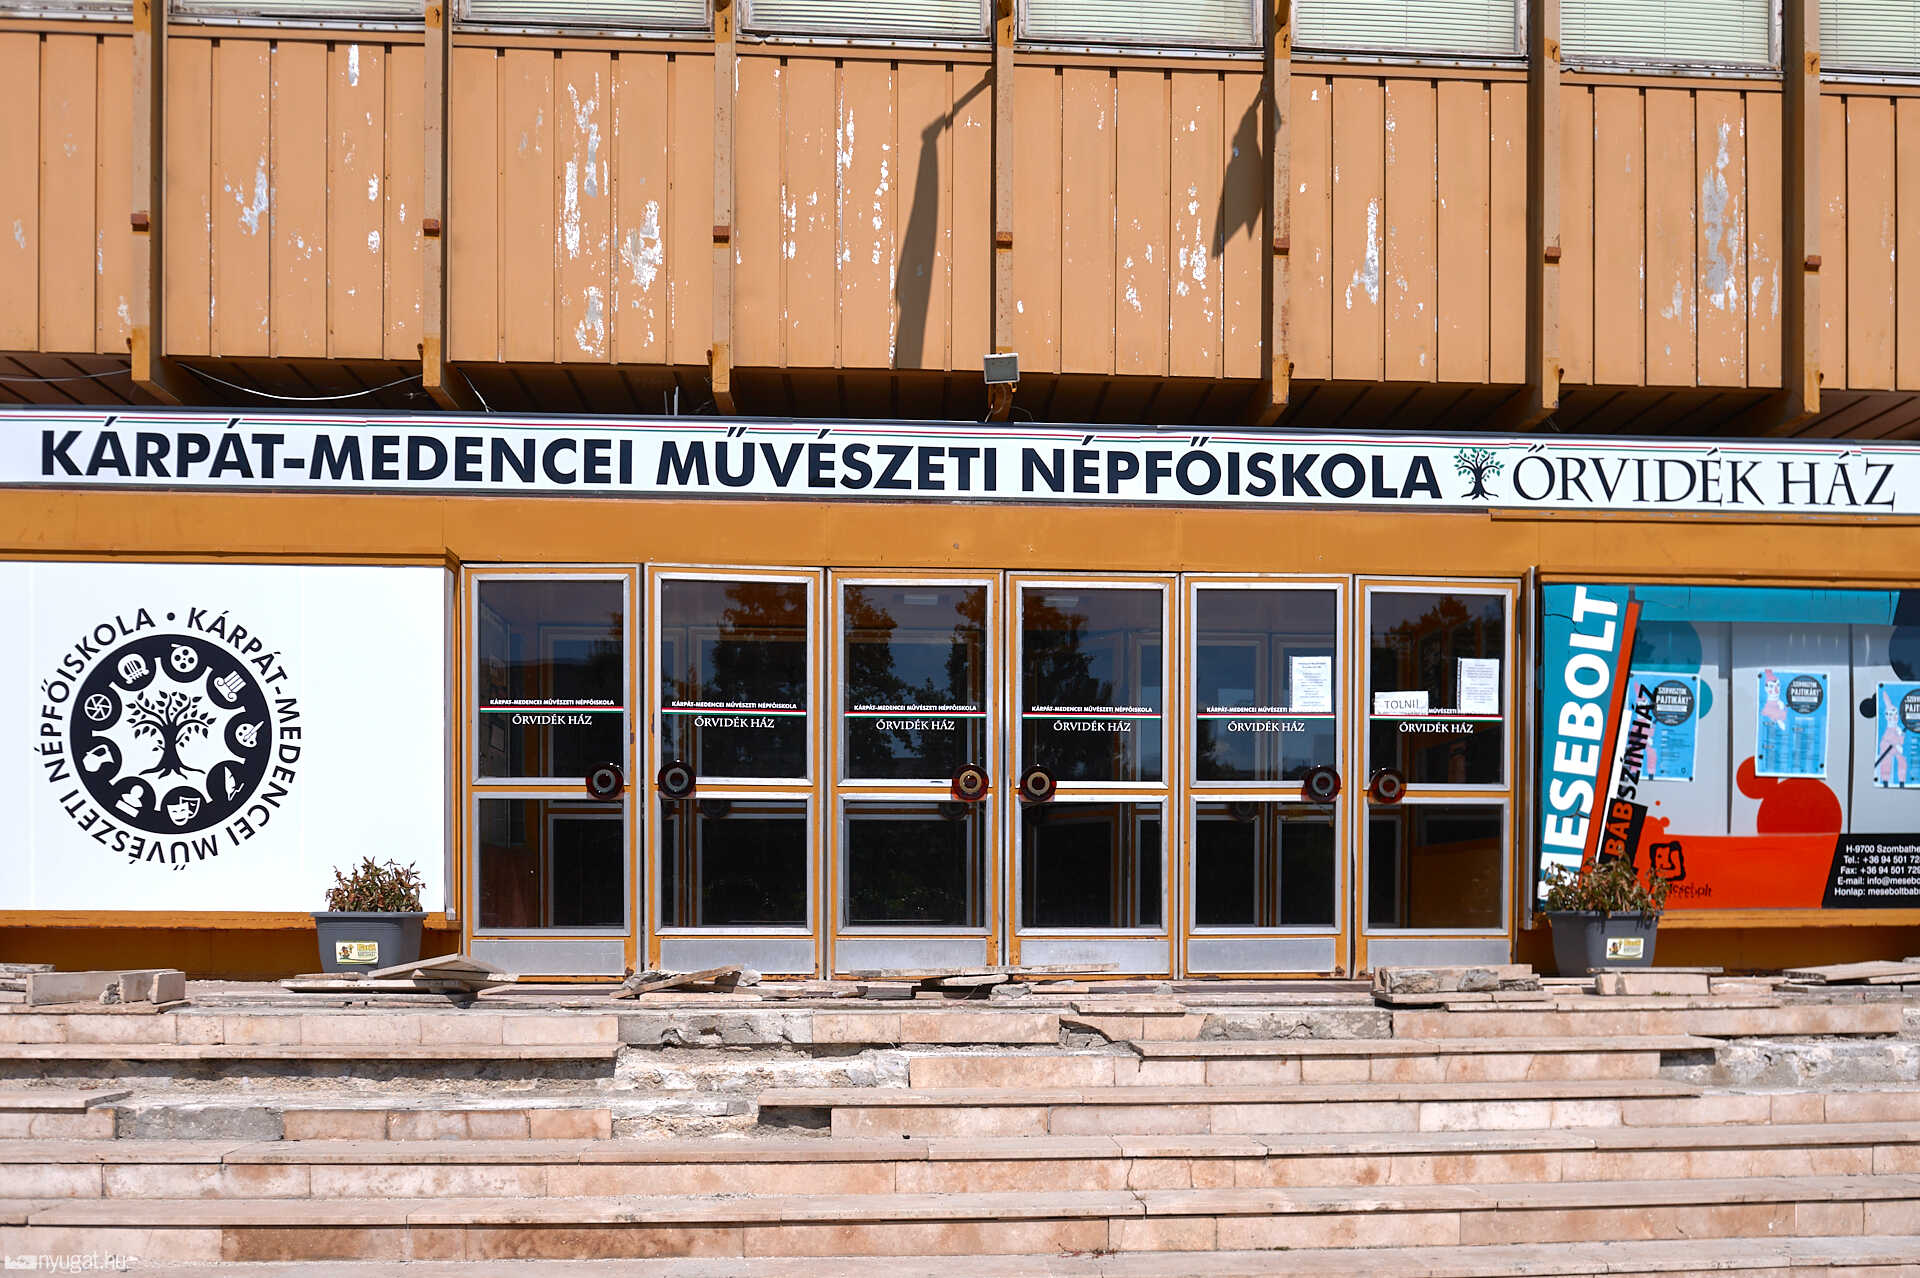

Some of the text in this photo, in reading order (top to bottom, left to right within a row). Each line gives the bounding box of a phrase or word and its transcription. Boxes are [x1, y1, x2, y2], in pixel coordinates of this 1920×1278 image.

[41, 415, 1443, 499] KÁRPÁT-MEDENCEI MŰVÉSZETI NÉPFŐISKOLA
[1512, 443, 1897, 512] ŐRVIDÉK HÁZ
[512, 713, 593, 726] ŐRVIDÉK HÁZ
[694, 716, 775, 729] ŐRVIDÉK HÁZ
[875, 719, 955, 731] ŐRVIDÉK HÁZ
[1053, 720, 1131, 732] ŐRVIDÉK HÁZ
[1227, 720, 1305, 732] ŐRVIDÉK HÁZ
[1399, 722, 1474, 734] ŐRVIDÉK HÁZ
[33, 606, 302, 871] KÁRPÁT-MEDENCEI MŰVÉSZETI NÉPFŐISKOLA
[1846, 844, 1875, 853] H-9700
[1843, 855, 1860, 864] Tel.:
[1863, 855, 1879, 864] +36
[1881, 855, 1891, 864] 94
[1893, 855, 1907, 864] 501
[1840, 866, 1857, 874] Fax:
[1860, 866, 1877, 874] +36
[1878, 866, 1889, 874] 94
[1890, 866, 1905, 874] 501
[1837, 876, 1865, 885] E-mail:
[1834, 887, 1866, 898] Honlap:
